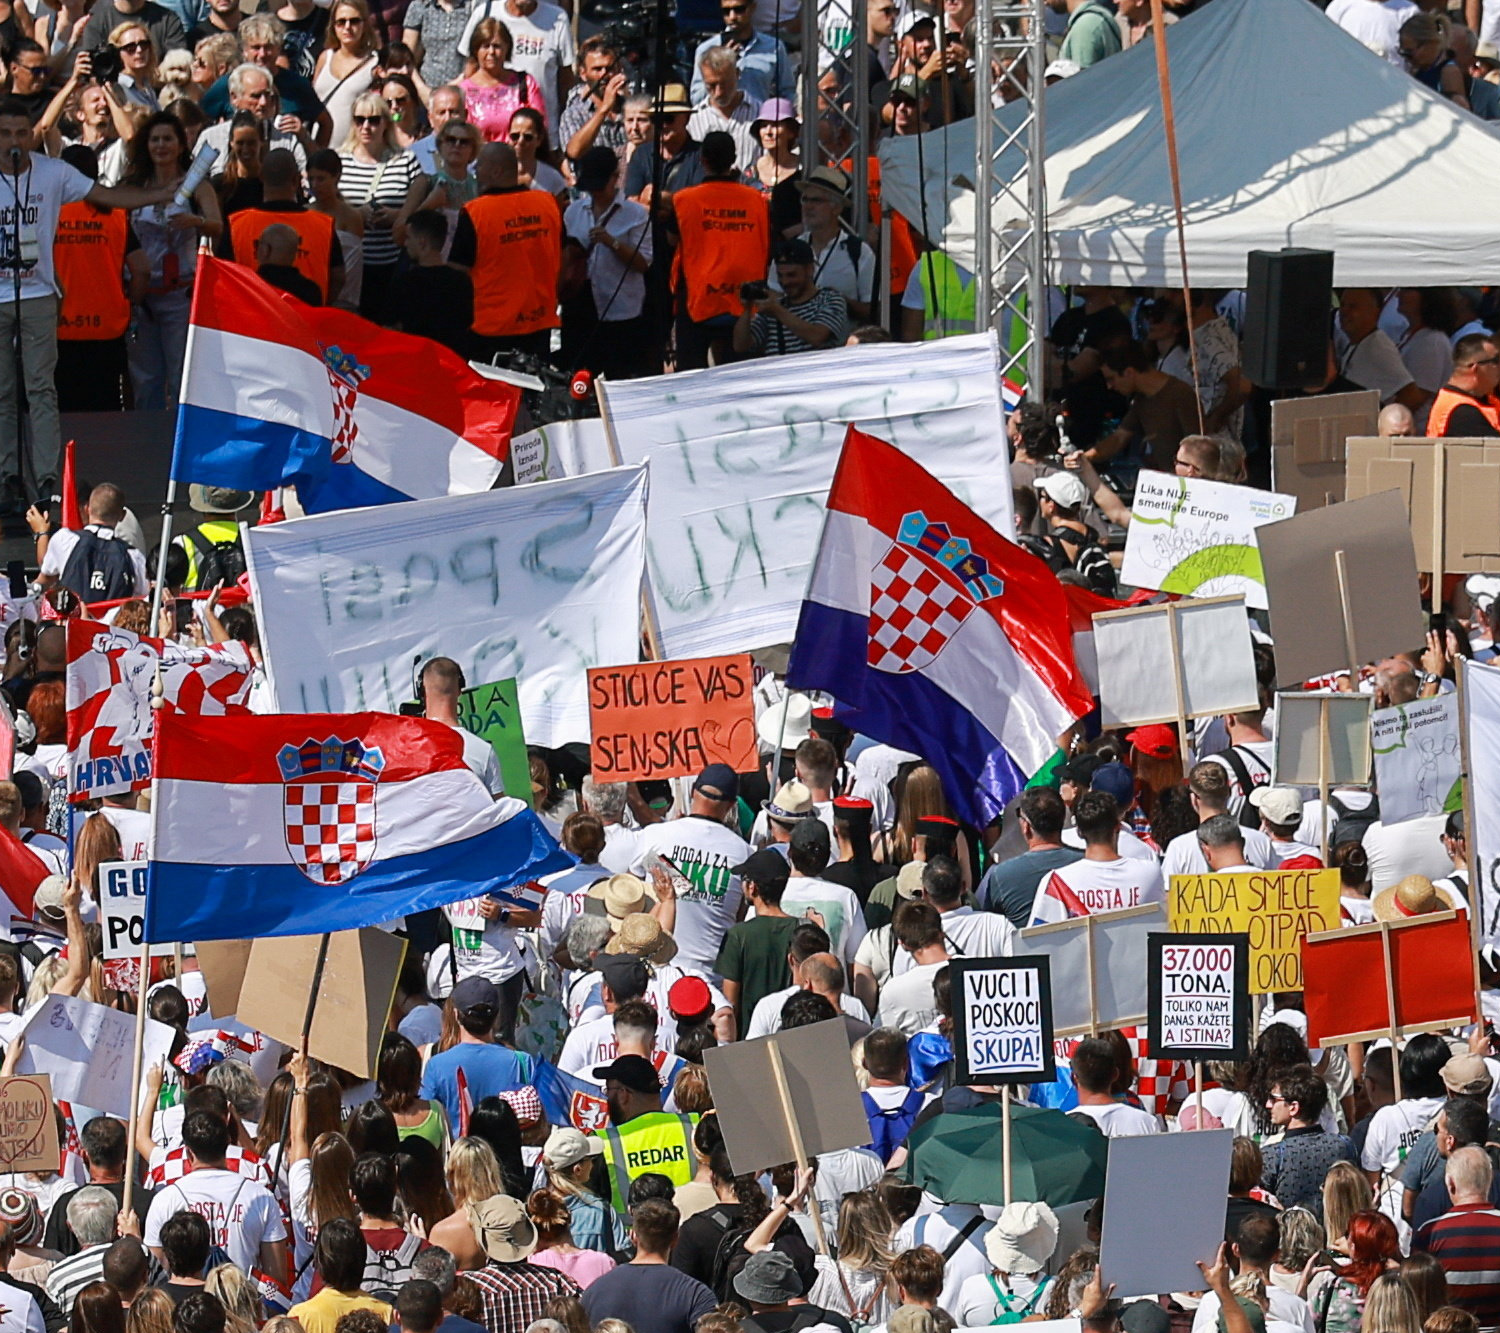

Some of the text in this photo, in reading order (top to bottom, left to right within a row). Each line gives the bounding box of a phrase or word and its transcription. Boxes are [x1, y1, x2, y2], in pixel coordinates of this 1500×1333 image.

[514, 437, 542, 454] Priroda
[518, 451, 538, 465] iznad
[1140, 483, 1192, 503] Lika NIJE
[1190, 507, 1230, 523] Europe
[693, 663, 745, 704] VAS
[1074, 888, 1113, 910] DOSTA
[1176, 871, 1322, 915] KADA SMEĆE
[1247, 911, 1327, 951] OTPAD
[1162, 948, 1232, 972] 37.000
[969, 971, 1031, 1001] VUCI I
[1164, 973, 1231, 995] TONA.
[970, 1000, 1040, 1031] POSKOCI
[1166, 1000, 1229, 1013] TOLIKO NAM
[1163, 1015, 1195, 1027] DANAS
[1164, 1028, 1231, 1044] A ISTINA?
[972, 1035, 1041, 1066] SKUPA!
[626, 1148, 685, 1171] REDAR
